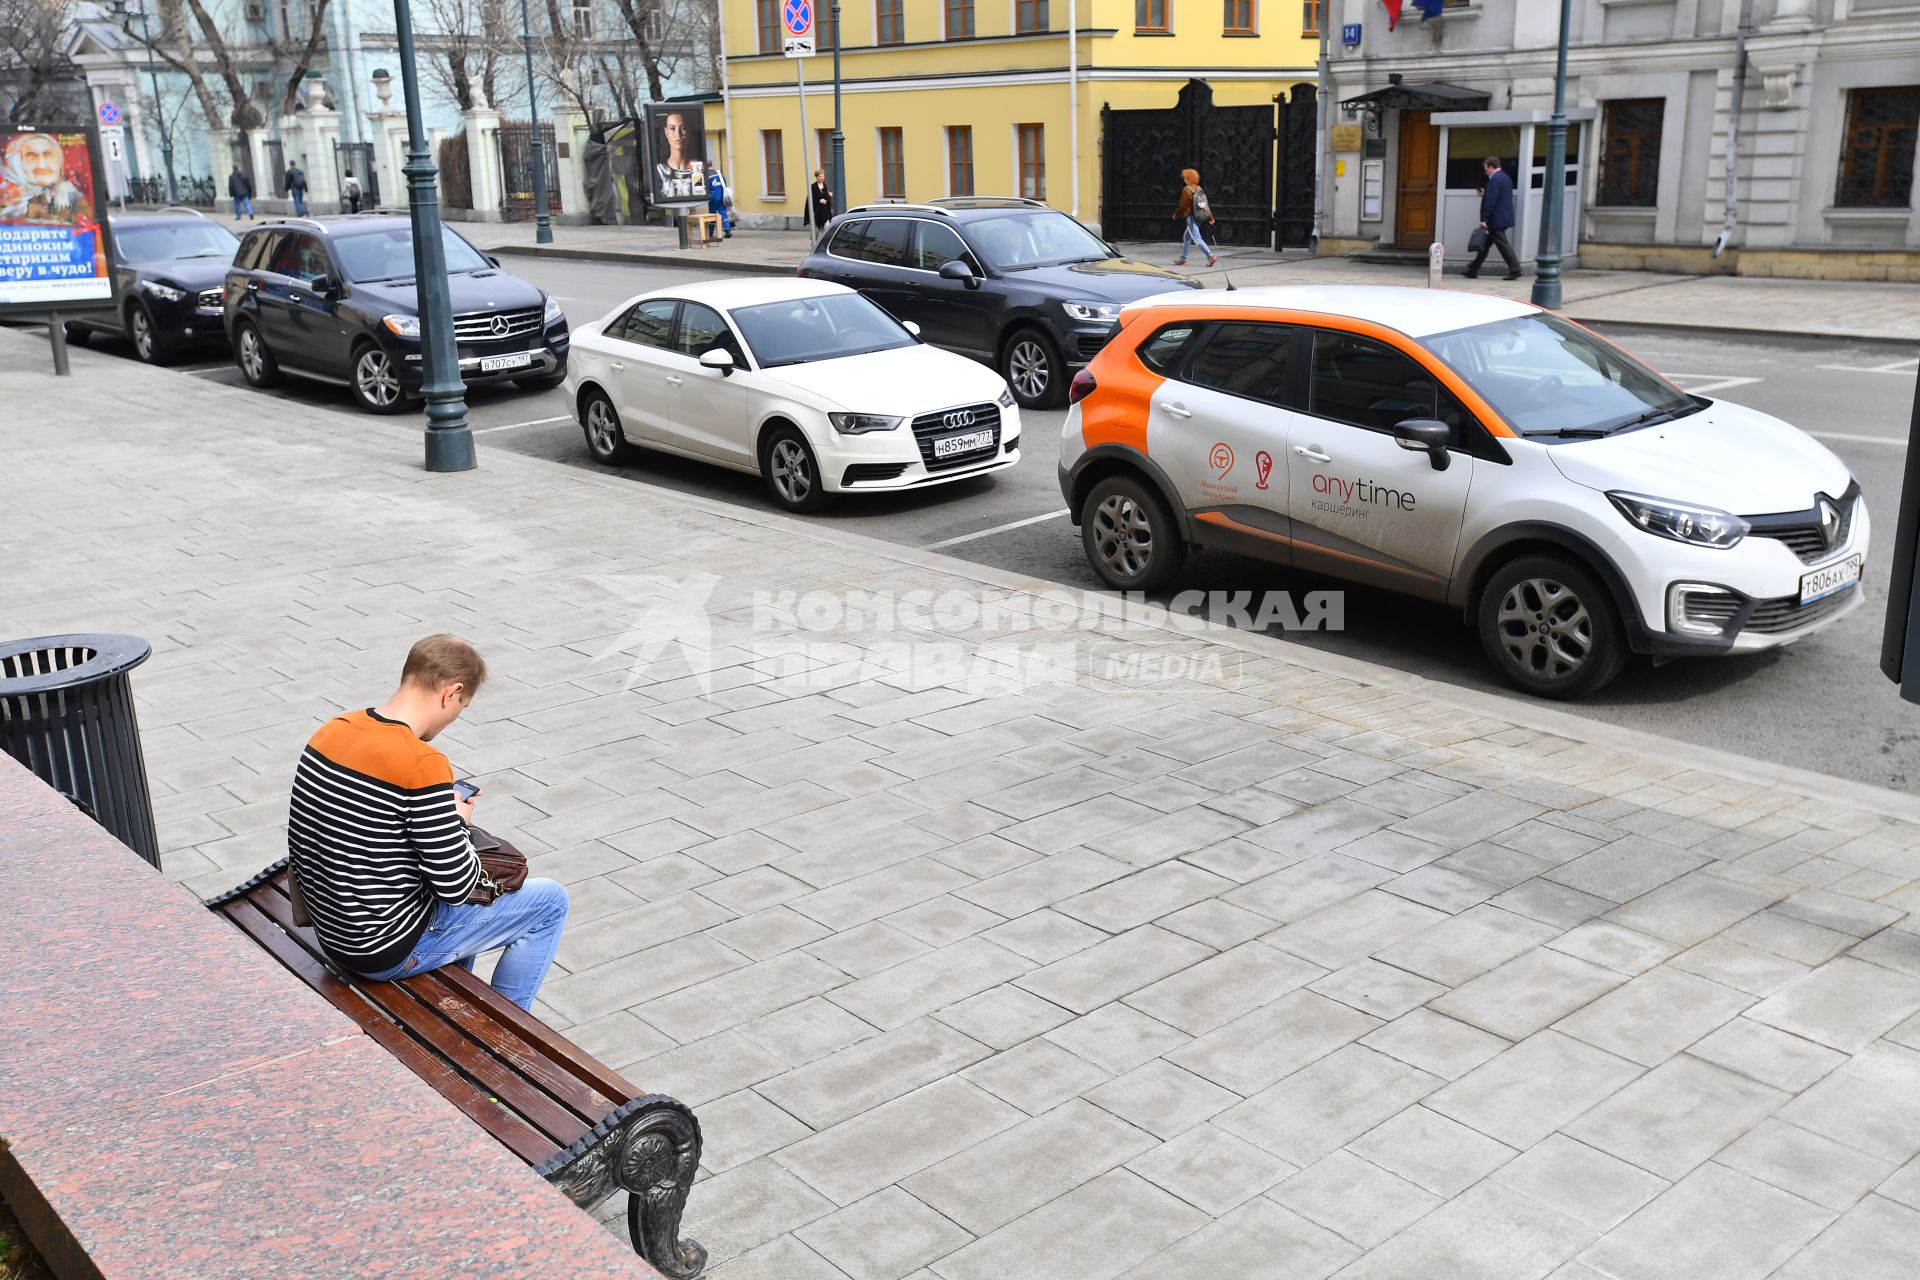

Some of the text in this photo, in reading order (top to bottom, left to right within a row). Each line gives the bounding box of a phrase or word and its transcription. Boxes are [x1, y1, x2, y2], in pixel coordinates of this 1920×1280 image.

[1345, 27, 1355, 39] 14
[0, 229, 67, 242] одарите
[38, 265, 47, 275] в
[51, 261, 92, 276] чудо!
[1200, 480, 1238, 493] Московский
[1312, 474, 1416, 511] anytime
[1311, 499, 1371, 519] каршеринг
